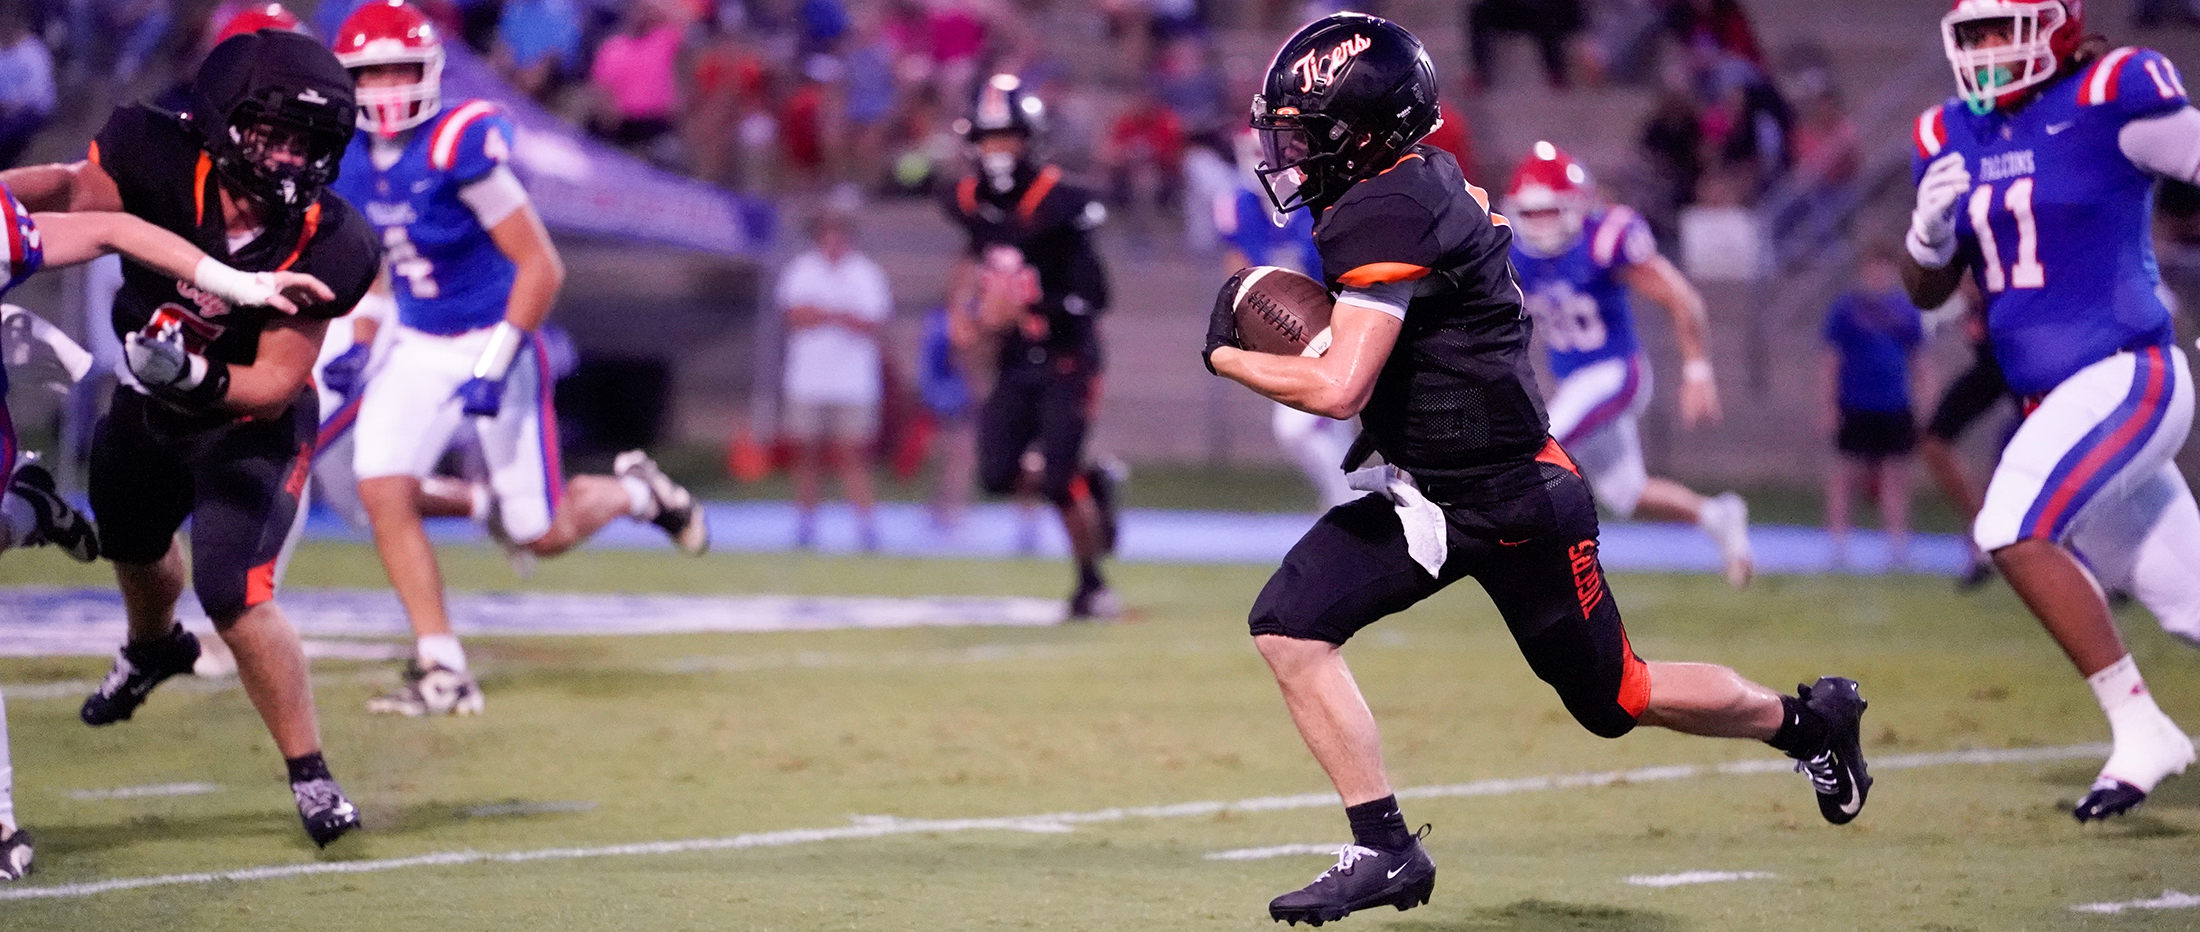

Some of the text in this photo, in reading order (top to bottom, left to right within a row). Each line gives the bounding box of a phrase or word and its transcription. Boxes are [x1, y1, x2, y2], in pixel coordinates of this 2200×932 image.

[1292, 34, 1371, 93] Tigers
[1979, 149, 2035, 182] FALCONS
[1967, 177, 2045, 292] 11
[1568, 539, 1603, 620] TIGERS
